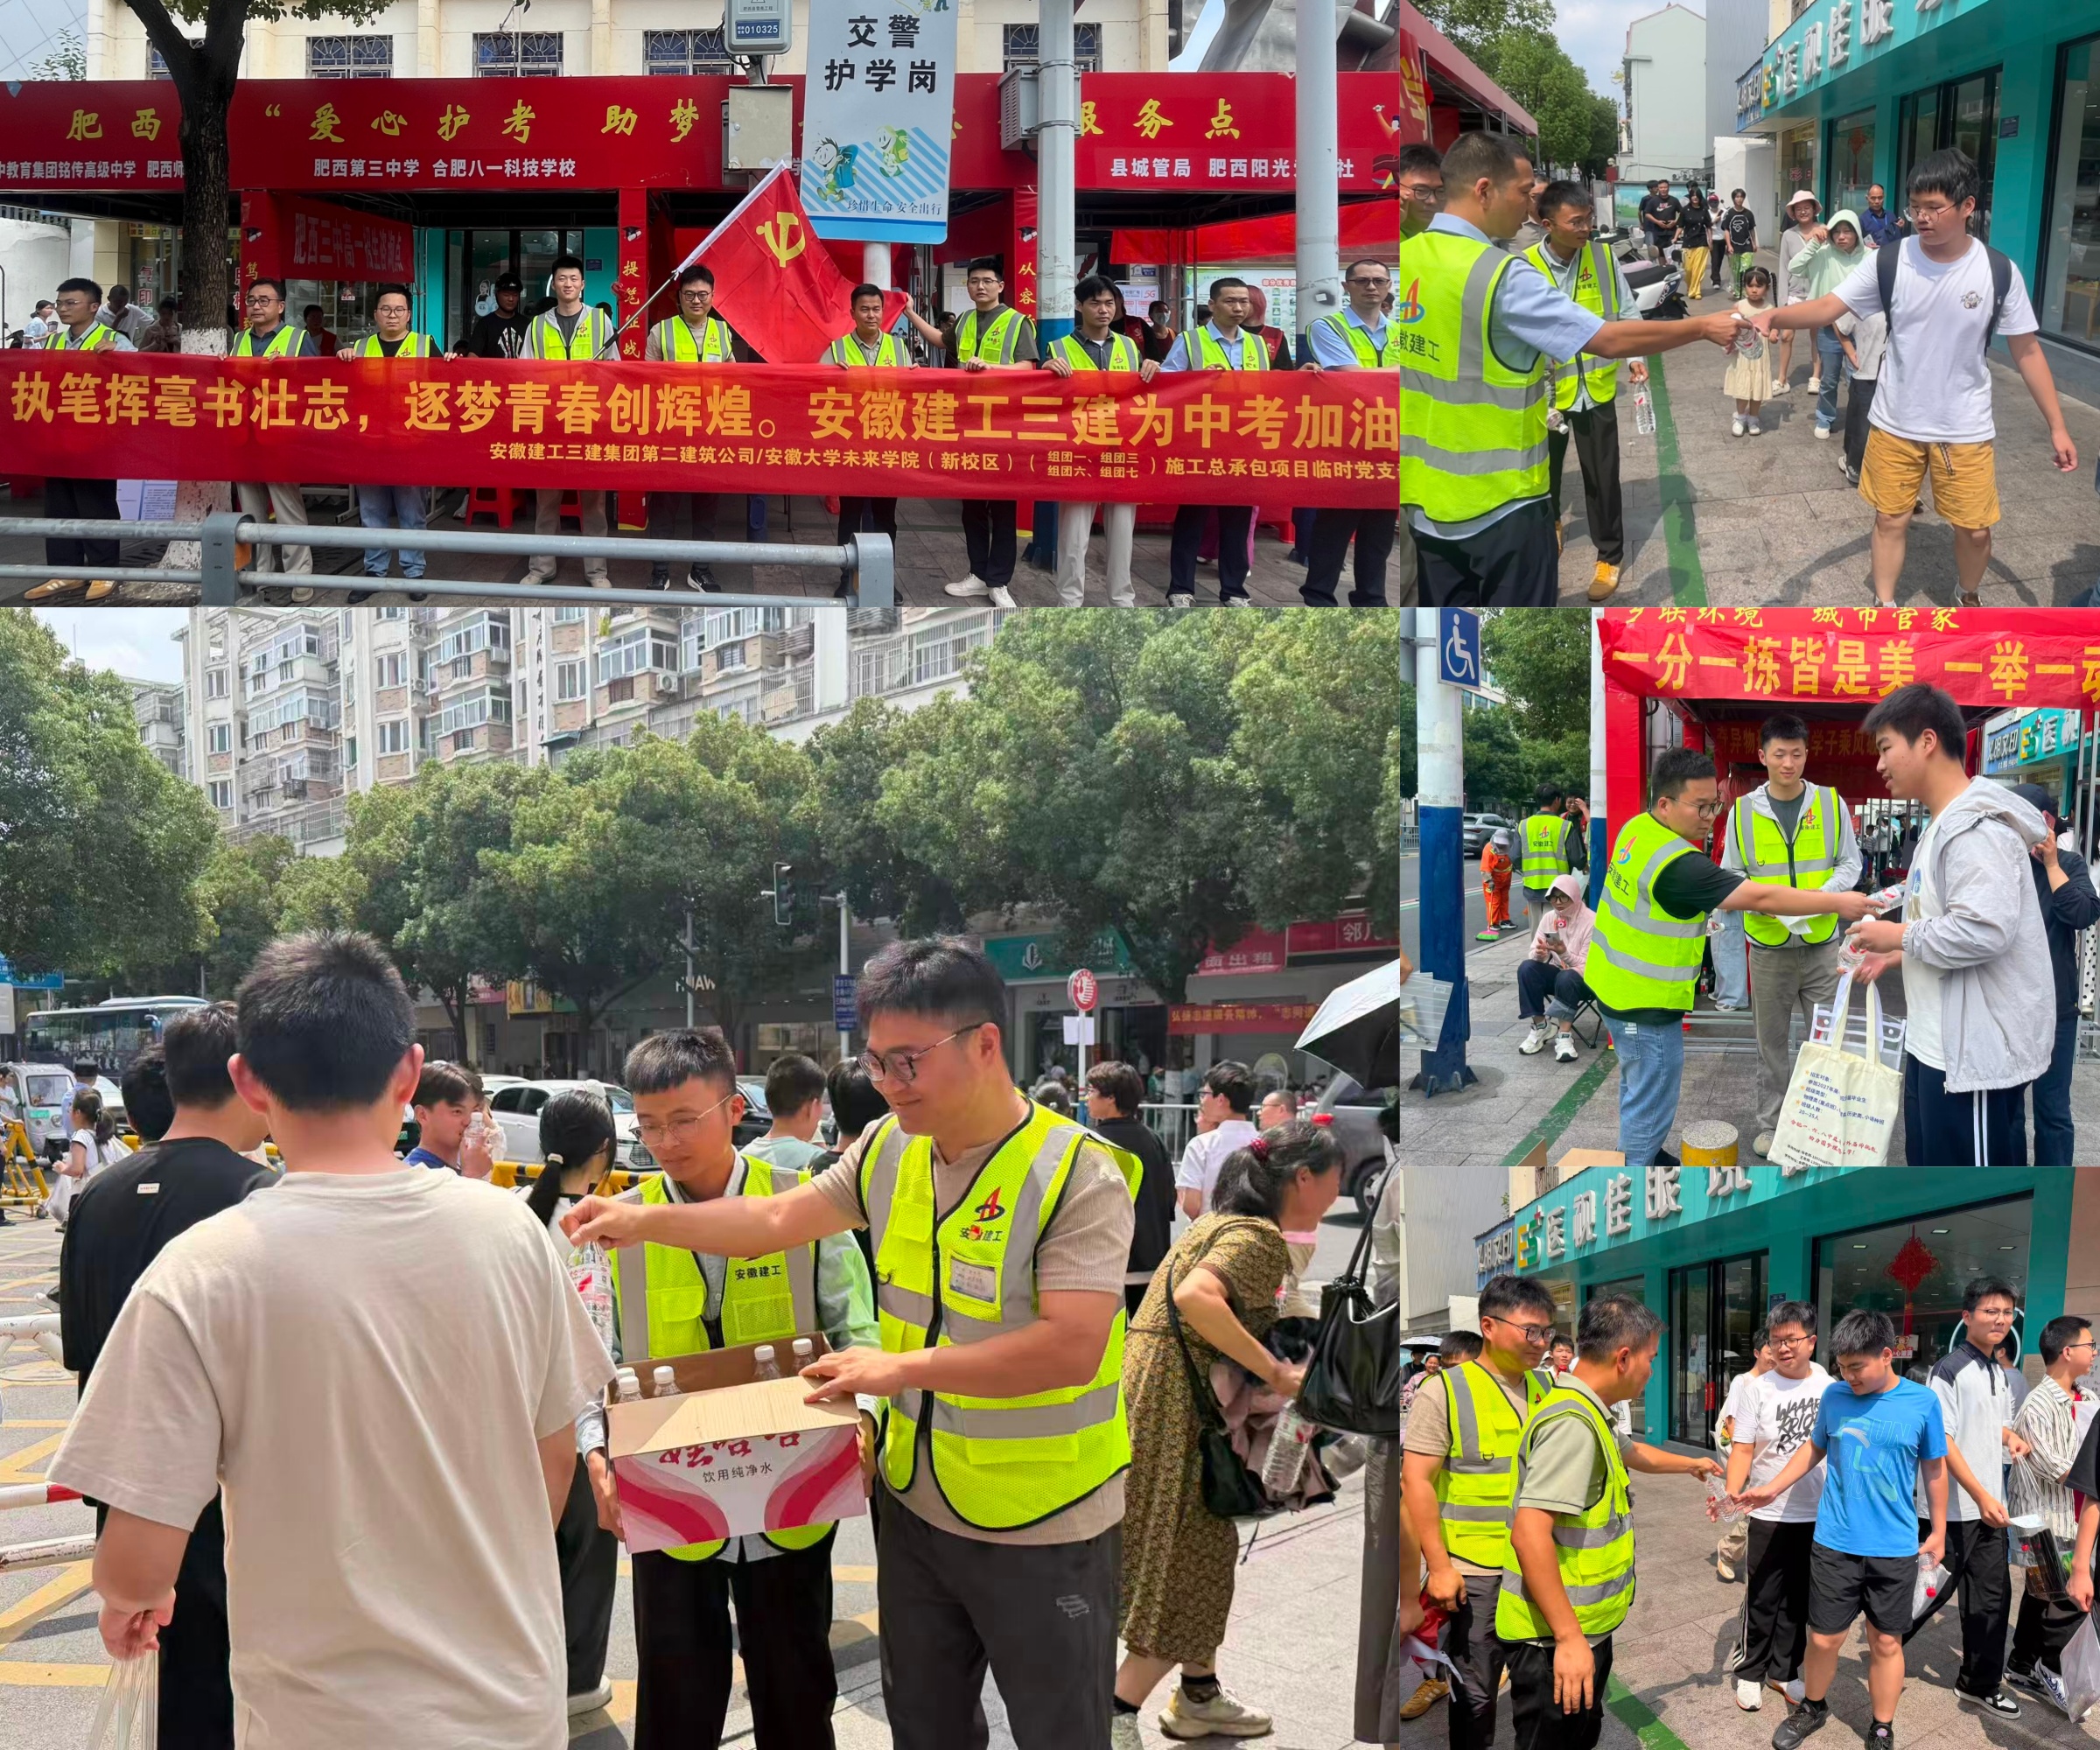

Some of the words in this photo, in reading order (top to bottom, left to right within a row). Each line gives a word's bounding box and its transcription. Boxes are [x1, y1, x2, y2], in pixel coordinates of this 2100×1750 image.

[745, 24, 778, 34] 010325
[847, 14, 920, 49] 交警
[824, 58, 936, 94] 护学岗
[313, 158, 420, 178] 肥西第三中学
[432, 158, 577, 178] 合肥八一科技学校
[1110, 158, 1191, 178] 县城管局
[1208, 158, 1354, 178] 肥西阳光社
[847, 200, 893, 214] 珍惜生命
[897, 201, 942, 216] 安全出行
[1612, 633, 1916, 696] 一分一拣皆是美
[959, 1226, 1004, 1242] 安建工
[734, 1264, 781, 1281] 安徽建工
[702, 1461, 774, 1484] 饮用纯净水
